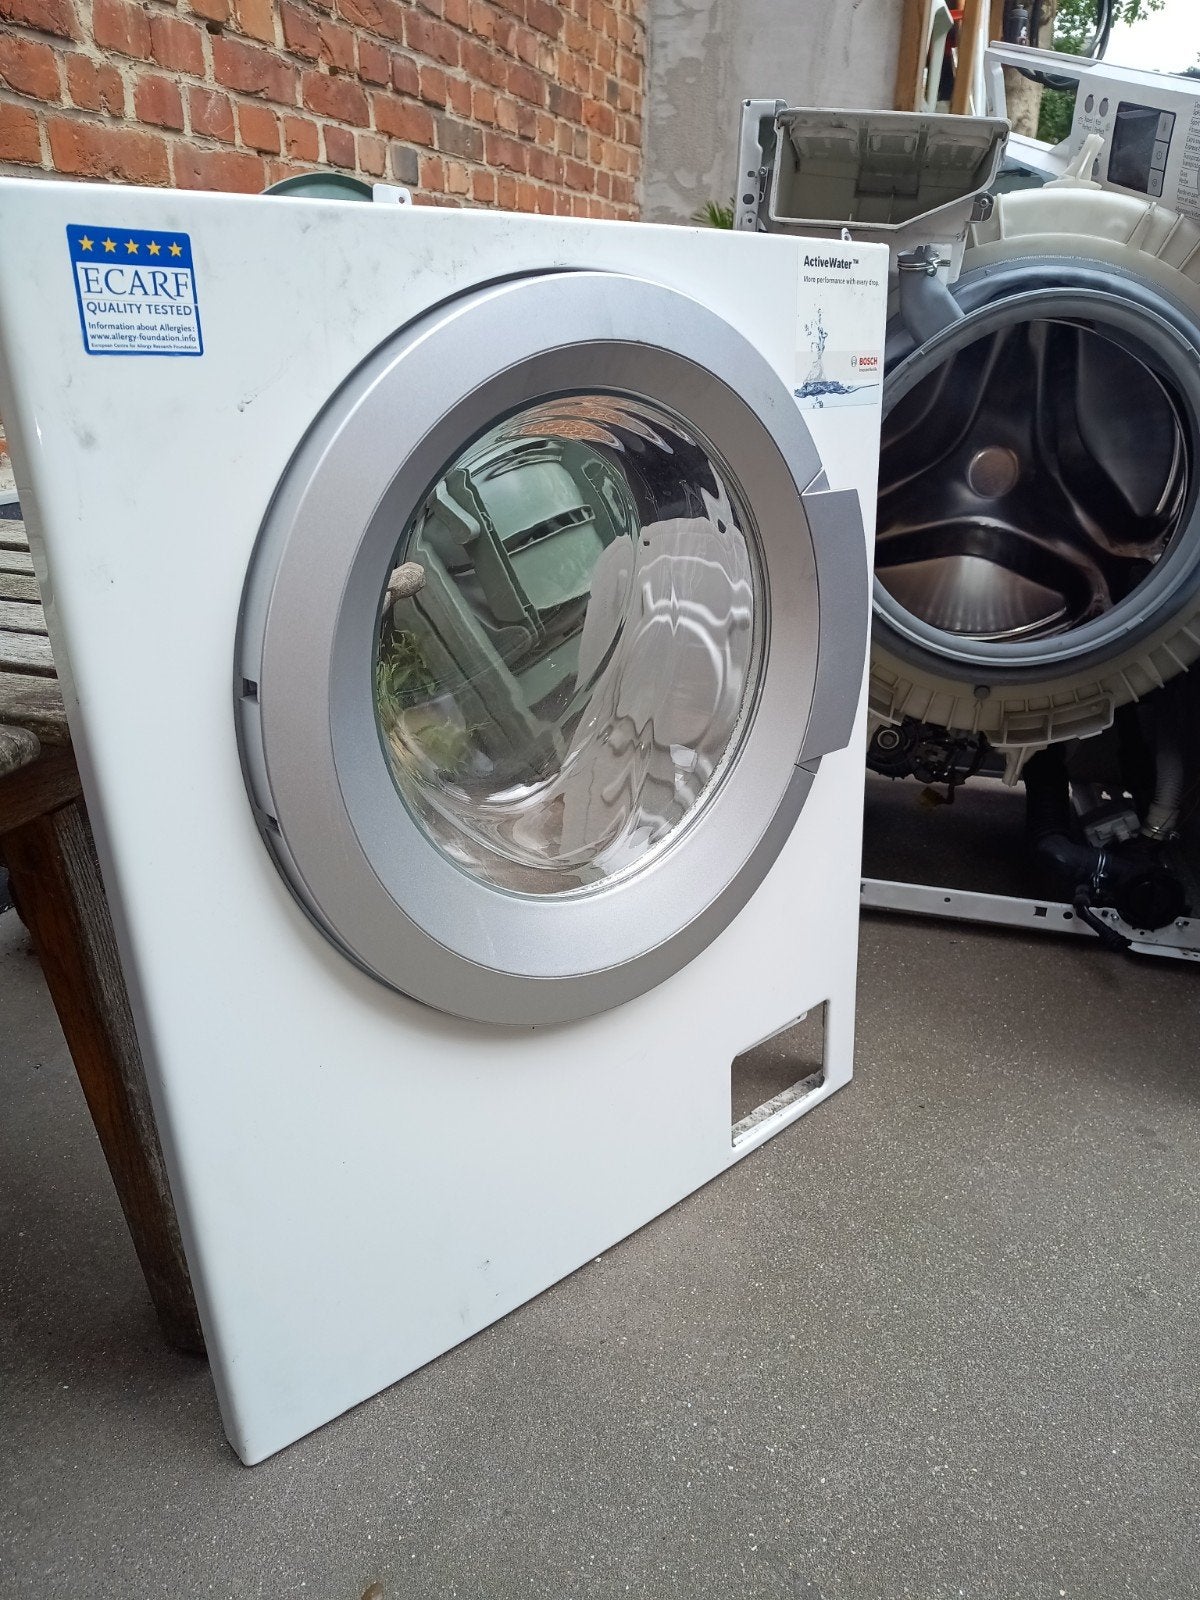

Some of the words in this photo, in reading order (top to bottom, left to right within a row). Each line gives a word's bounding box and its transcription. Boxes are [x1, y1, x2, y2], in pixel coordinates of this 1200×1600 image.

[81, 267, 189, 301] ECARF
[803, 275, 816, 283] More
[816, 276, 846, 285] performance
[846, 278, 856, 286] with
[856, 279, 868, 287] every
[86, 302, 142, 315] QUALITY
[146, 304, 192, 316] TESTED
[88, 322, 135, 331] Information
[136, 323, 158, 332] about
[160, 324, 195, 334] Allergies:
[90, 332, 196, 342] www.allergy-foundation.info
[859, 357, 878, 366] BOSCH
